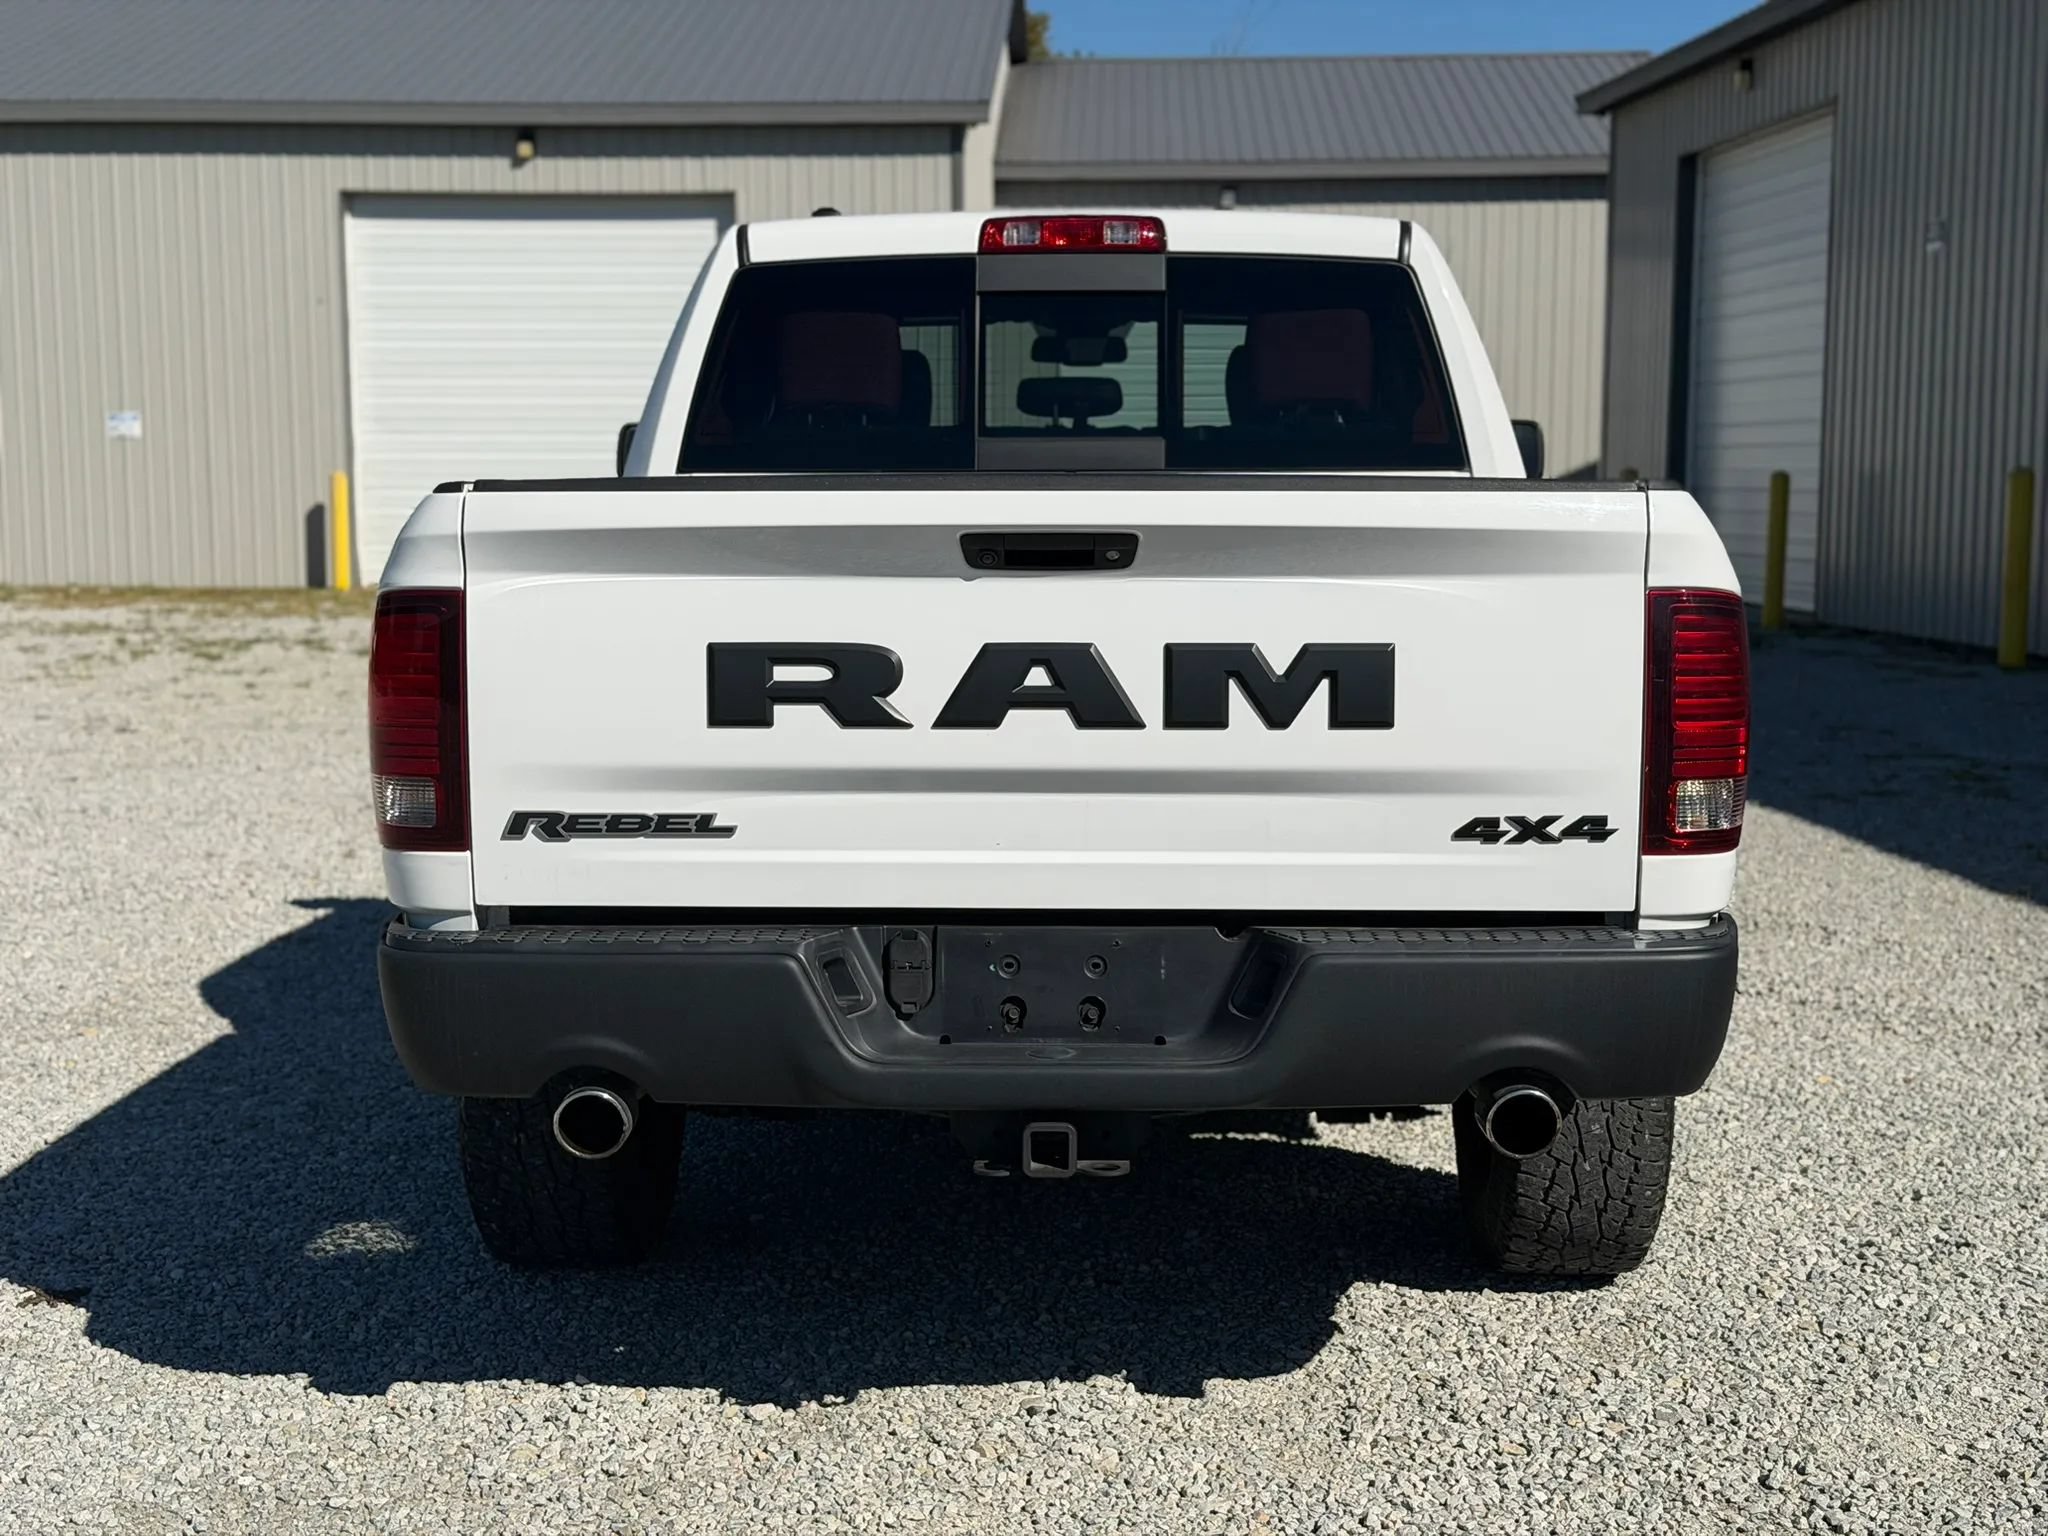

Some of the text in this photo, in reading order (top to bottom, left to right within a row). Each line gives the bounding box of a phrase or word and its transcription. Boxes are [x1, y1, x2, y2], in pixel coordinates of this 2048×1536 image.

[706, 642, 1396, 731] RAM
[500, 811, 738, 843] REBEL
[1450, 815, 1620, 845] 4X4
